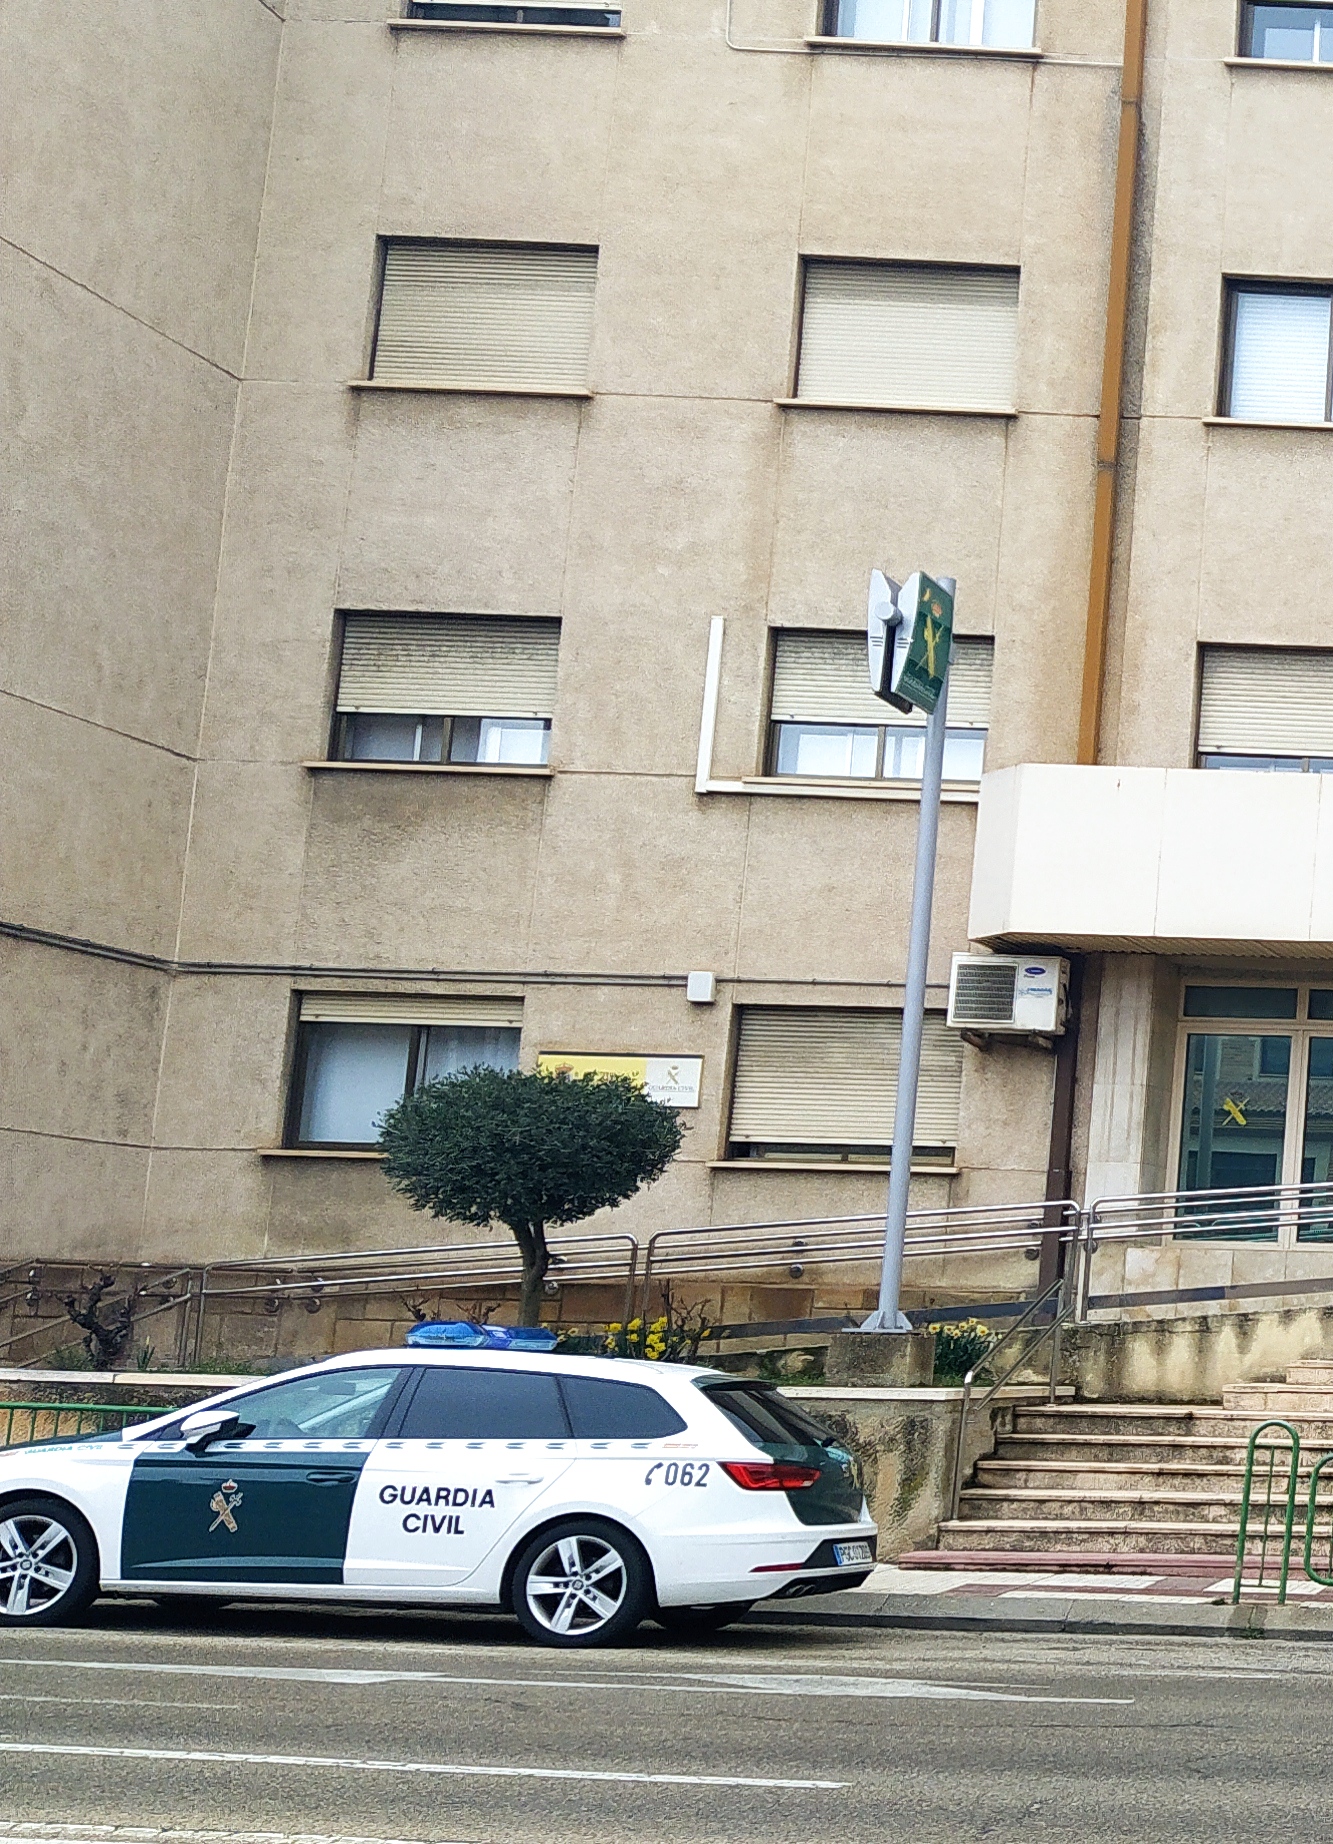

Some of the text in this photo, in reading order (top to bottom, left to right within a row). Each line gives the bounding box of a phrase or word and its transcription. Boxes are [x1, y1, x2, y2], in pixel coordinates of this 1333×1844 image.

[664, 1461, 710, 1488] 062
[378, 1484, 496, 1509] GUARDIA
[402, 1512, 465, 1535] CIVIL
